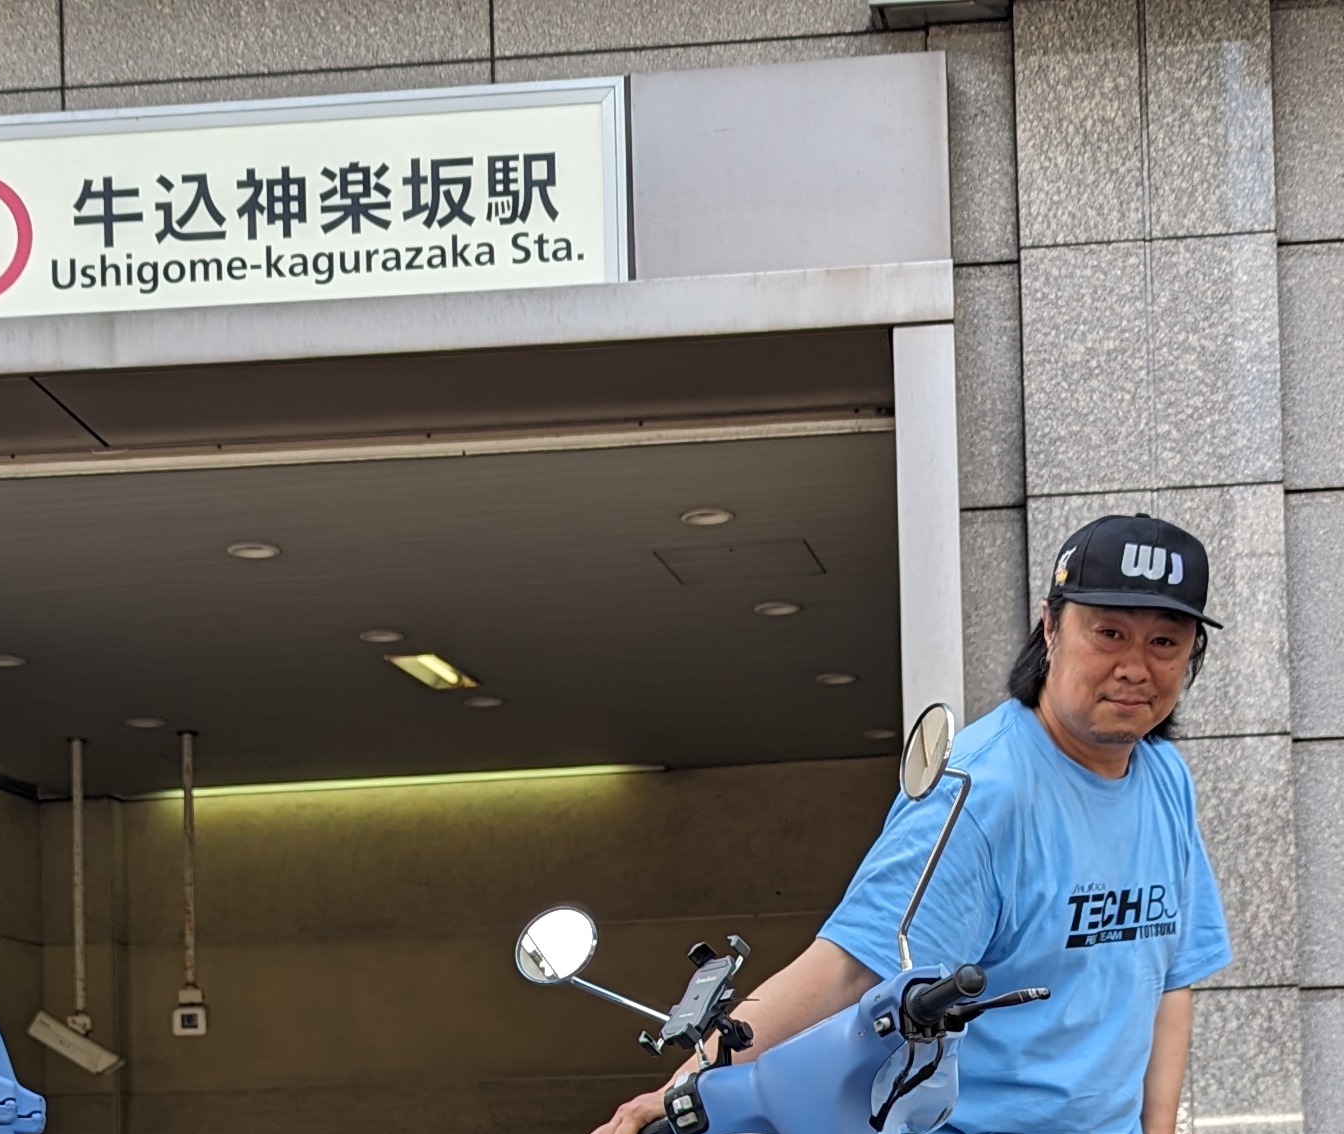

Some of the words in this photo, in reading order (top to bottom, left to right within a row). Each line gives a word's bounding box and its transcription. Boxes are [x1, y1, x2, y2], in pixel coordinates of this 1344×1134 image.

[72, 150, 561, 249] 牛込神楽坂駅
[50, 233, 496, 294] Ushigome-kagurazaka
[511, 231, 586, 265] Sta.
[1067, 888, 1143, 932] TECH
